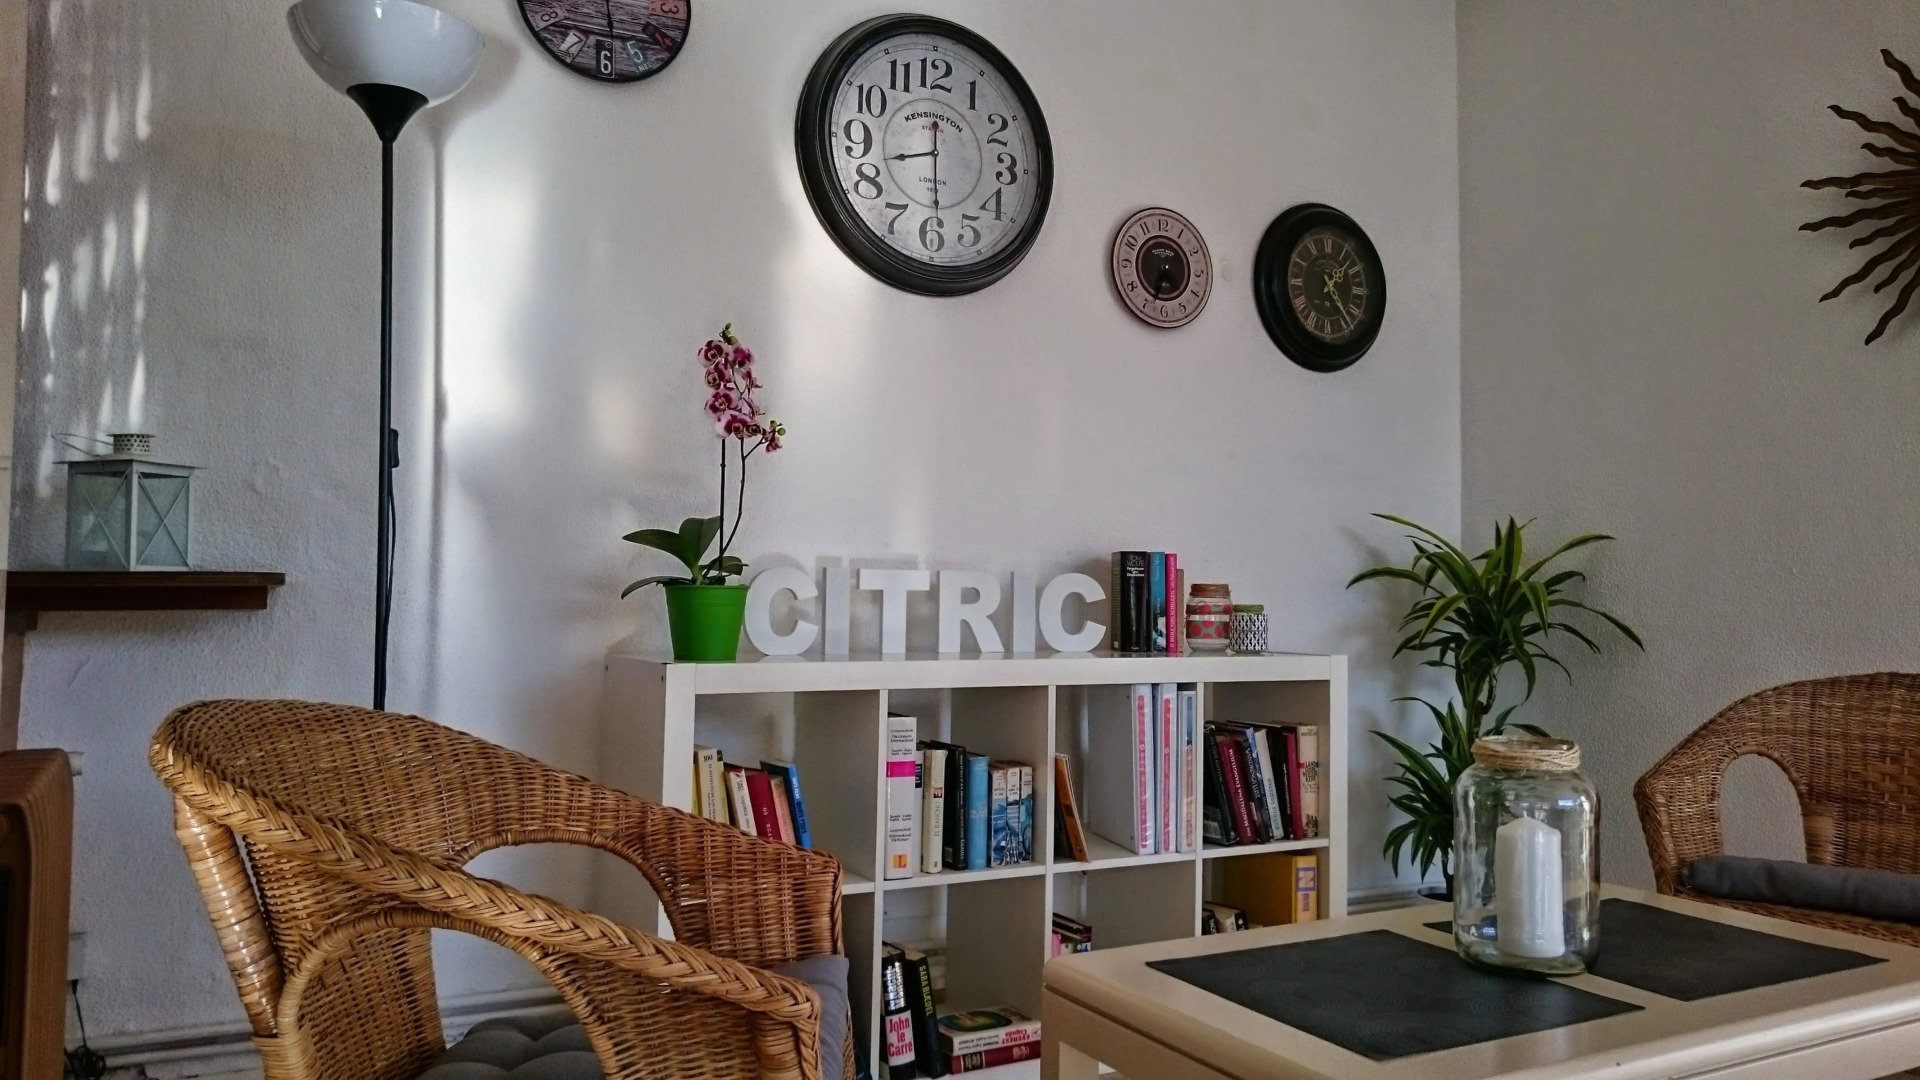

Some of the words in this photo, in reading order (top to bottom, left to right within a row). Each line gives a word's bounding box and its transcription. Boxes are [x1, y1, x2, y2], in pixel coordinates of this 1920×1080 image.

[540, 11, 558, 23] 8
[565, 32, 584, 52] 7
[626, 40, 643, 63] 5
[600, 50, 612, 74] 6
[887, 58, 912, 94] 11
[918, 56, 952, 93] 12
[856, 83, 887, 118] 10
[966, 80, 978, 112] 1
[904, 111, 963, 133] KENSINGTON
[987, 113, 1008, 147] 2
[843, 119, 872, 159] 9
[853, 162, 883, 199] 8
[995, 152, 1018, 186] 3
[978, 187, 1007, 222] 4
[884, 202, 908, 235] 7
[1140, 222, 1150, 236] 11
[1158, 218, 1169, 232] 12
[918, 216, 944, 252] 6
[957, 214, 981, 248] 5
[1177, 228, 1184, 240] 1
[1125, 235, 1138, 251] 10
[1188, 246, 1199, 257] 2
[1122, 259, 1132, 269] 9
[1127, 280, 1138, 292] 8
[1160, 304, 1168, 318] 6
[1178, 302, 1187, 314] 5
[744, 566, 1106, 656] CITRIC
[1228, 748, 1241, 789] EVANGELIUM
[1238, 790, 1250, 827] MAGDALENA
[898, 854, 906, 868] L
[889, 1017, 910, 1033] John
[896, 1031, 906, 1043] le
[1002, 1034, 1030, 1044] EVEREST
